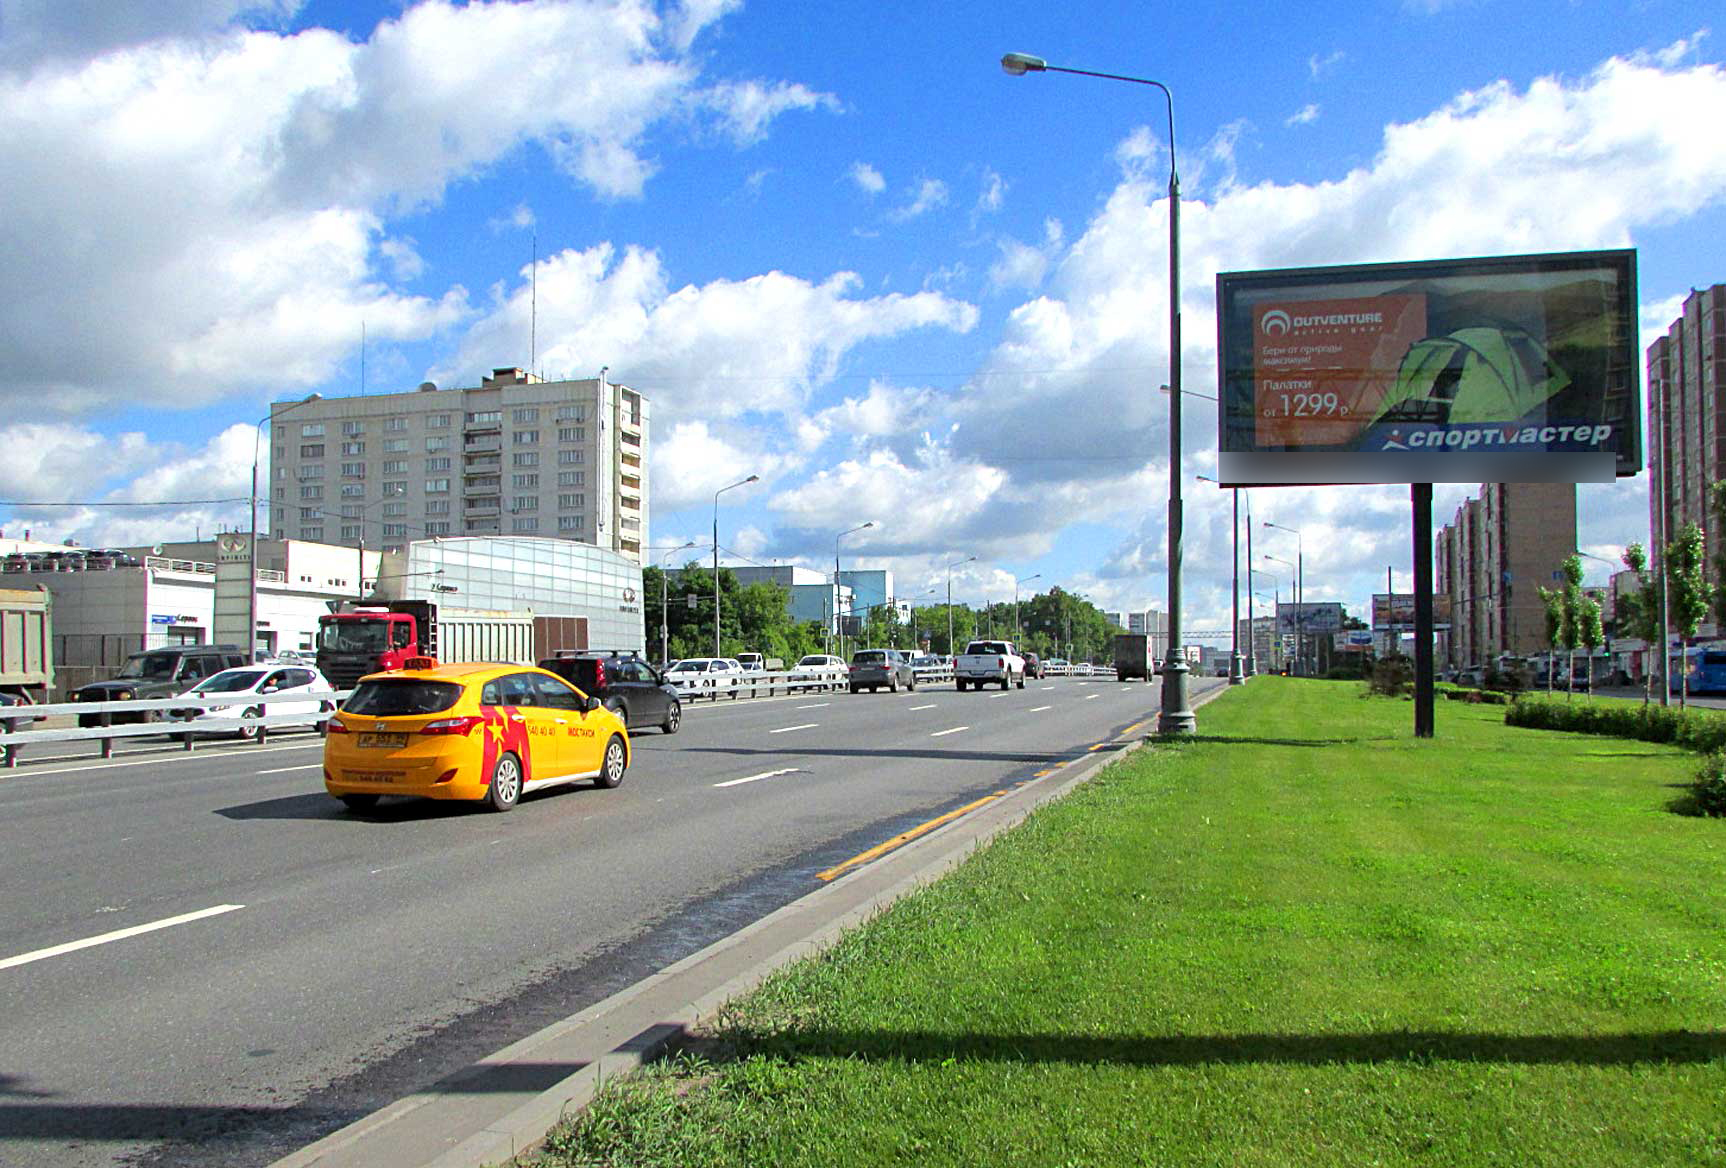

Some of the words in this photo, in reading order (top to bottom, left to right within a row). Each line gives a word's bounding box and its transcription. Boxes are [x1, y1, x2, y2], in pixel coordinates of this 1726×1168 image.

[1293, 313, 1383, 327] OUTVENTURE
[1288, 347, 1298, 355] от
[1300, 344, 1343, 355] природы
[1263, 379, 1312, 391] Палатки
[1263, 409, 1276, 417] от
[1280, 392, 1338, 417] 1299
